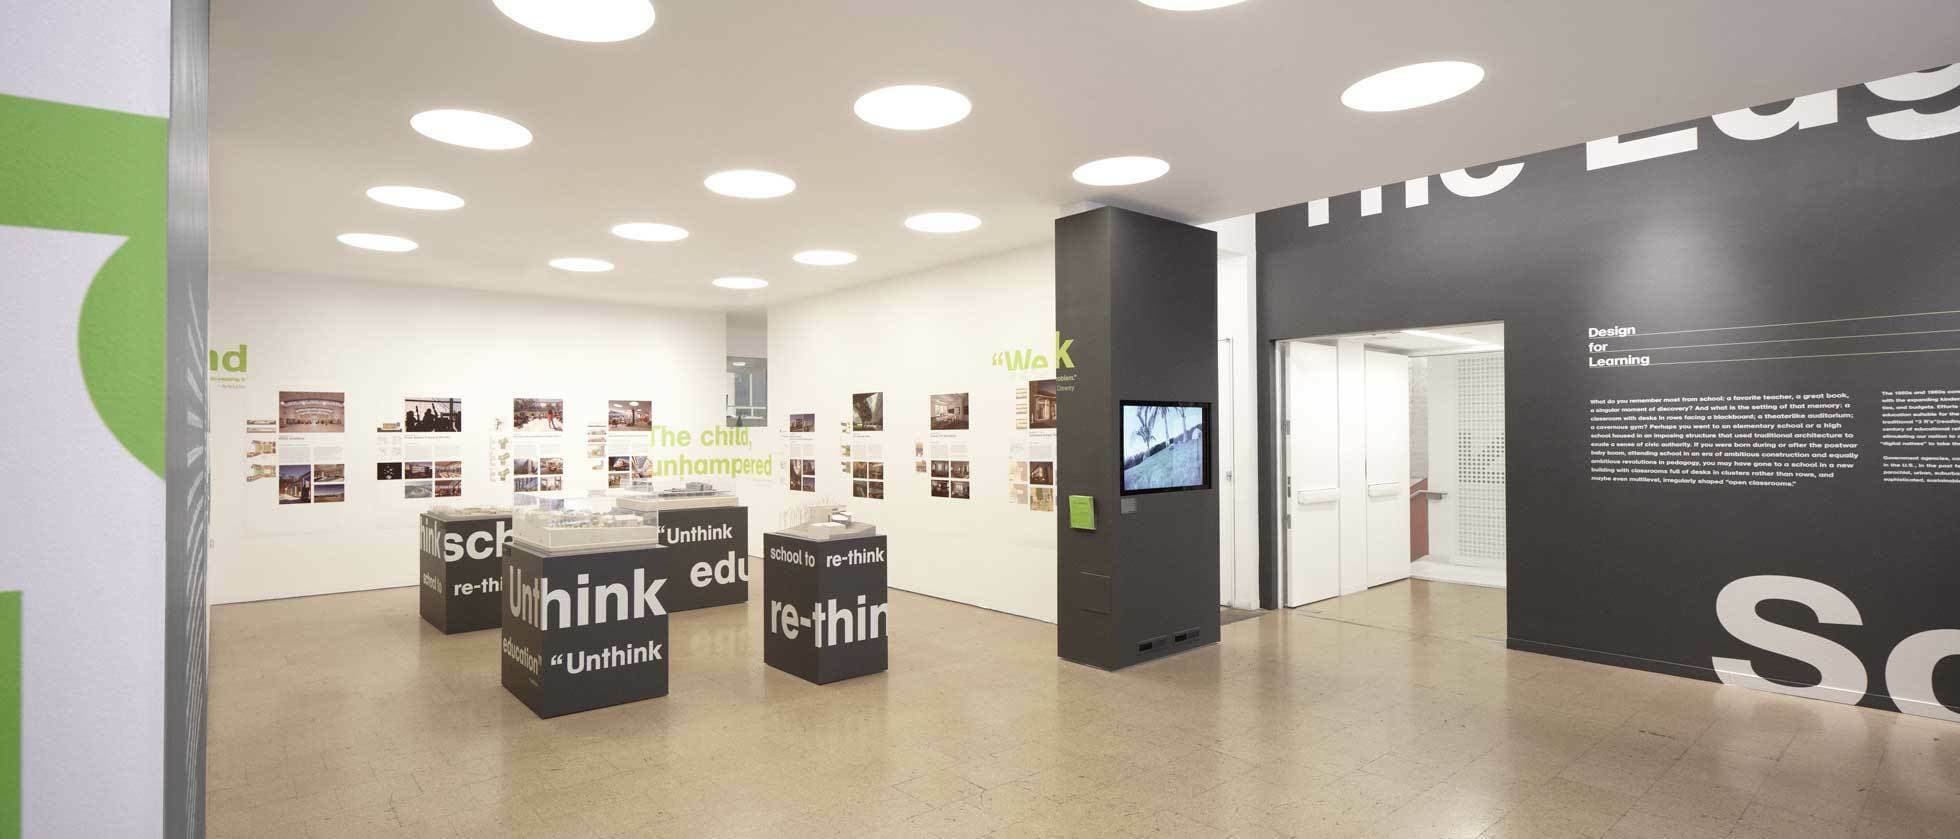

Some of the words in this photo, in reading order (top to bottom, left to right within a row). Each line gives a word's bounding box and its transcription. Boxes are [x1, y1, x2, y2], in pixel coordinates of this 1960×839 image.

[1588, 325, 1636, 338] Design
[1588, 342, 1608, 353] for
[1588, 355, 1650, 366] Learning
[1803, 393, 1824, 401] great
[1596, 406, 1620, 414] singular
[1751, 404, 1777, 412] setting
[1684, 414, 1705, 422] facing
[1752, 442, 1776, 450] during
[1824, 442, 1857, 450] postwar
[1590, 450, 1605, 458] baby
[1627, 450, 1658, 458] attending
[1828, 452, 1858, 460] equally
[1591, 467, 1615, 475] building
[1591, 475, 1611, 483] maybe
[1698, 478, 1724, 486] shaped
[770, 546, 802, 565] school
[804, 551, 815, 568] to
[826, 548, 885, 567] re-think
[509, 565, 668, 631] Unthink
[502, 637, 542, 675] education”
[551, 640, 663, 675] “Unthink
